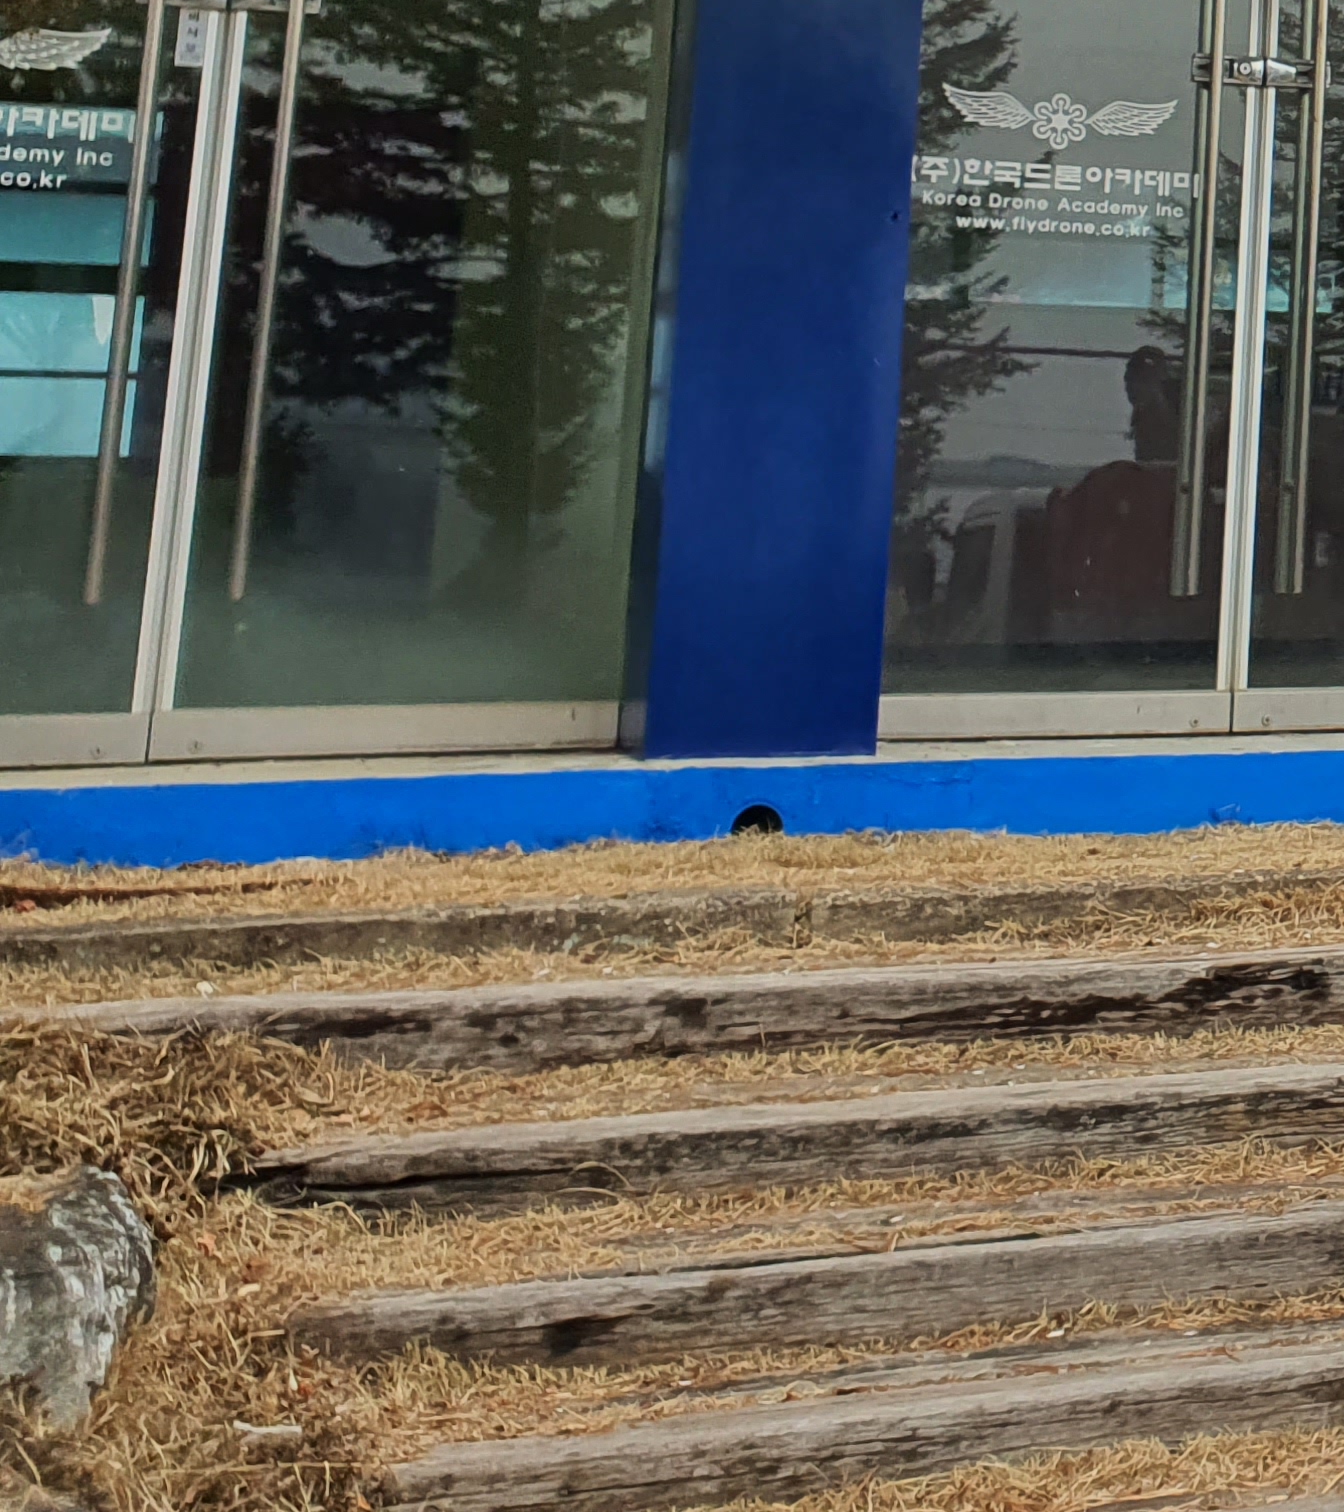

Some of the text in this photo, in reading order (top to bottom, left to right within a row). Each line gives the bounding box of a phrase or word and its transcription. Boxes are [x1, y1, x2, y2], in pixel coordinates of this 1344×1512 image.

[76, 147, 113, 166] Inc
[911, 155, 1199, 198] (주)한국드론아카데미
[922, 189, 1184, 218] Korea Drone Academy Inc
[955, 214, 1151, 238] www.flydrone.co.kr
